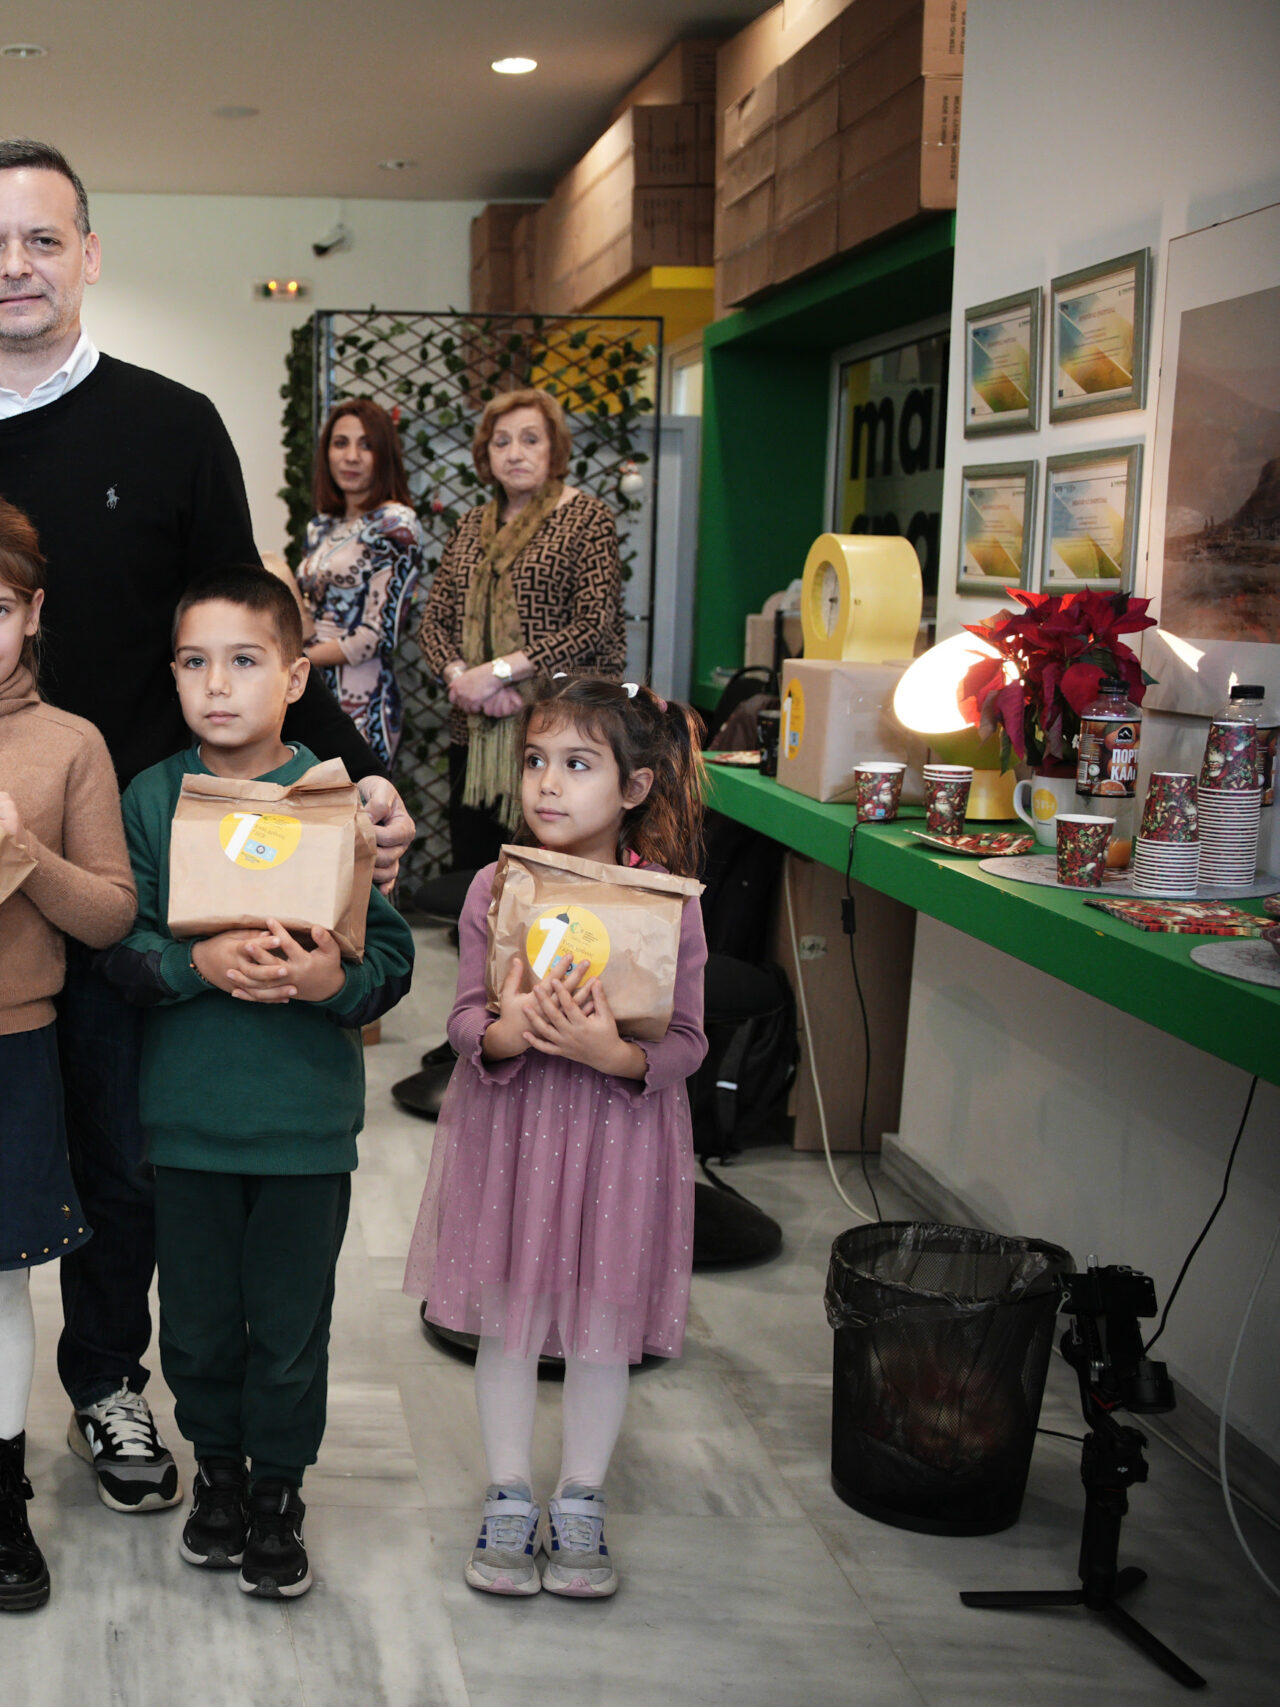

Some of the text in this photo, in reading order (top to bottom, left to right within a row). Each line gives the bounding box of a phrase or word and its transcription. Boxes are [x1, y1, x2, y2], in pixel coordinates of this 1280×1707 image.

[1112, 749, 1138, 764] ΠΟΡΤ
[225, 813, 262, 862] 1
[532, 918, 569, 980] 1
